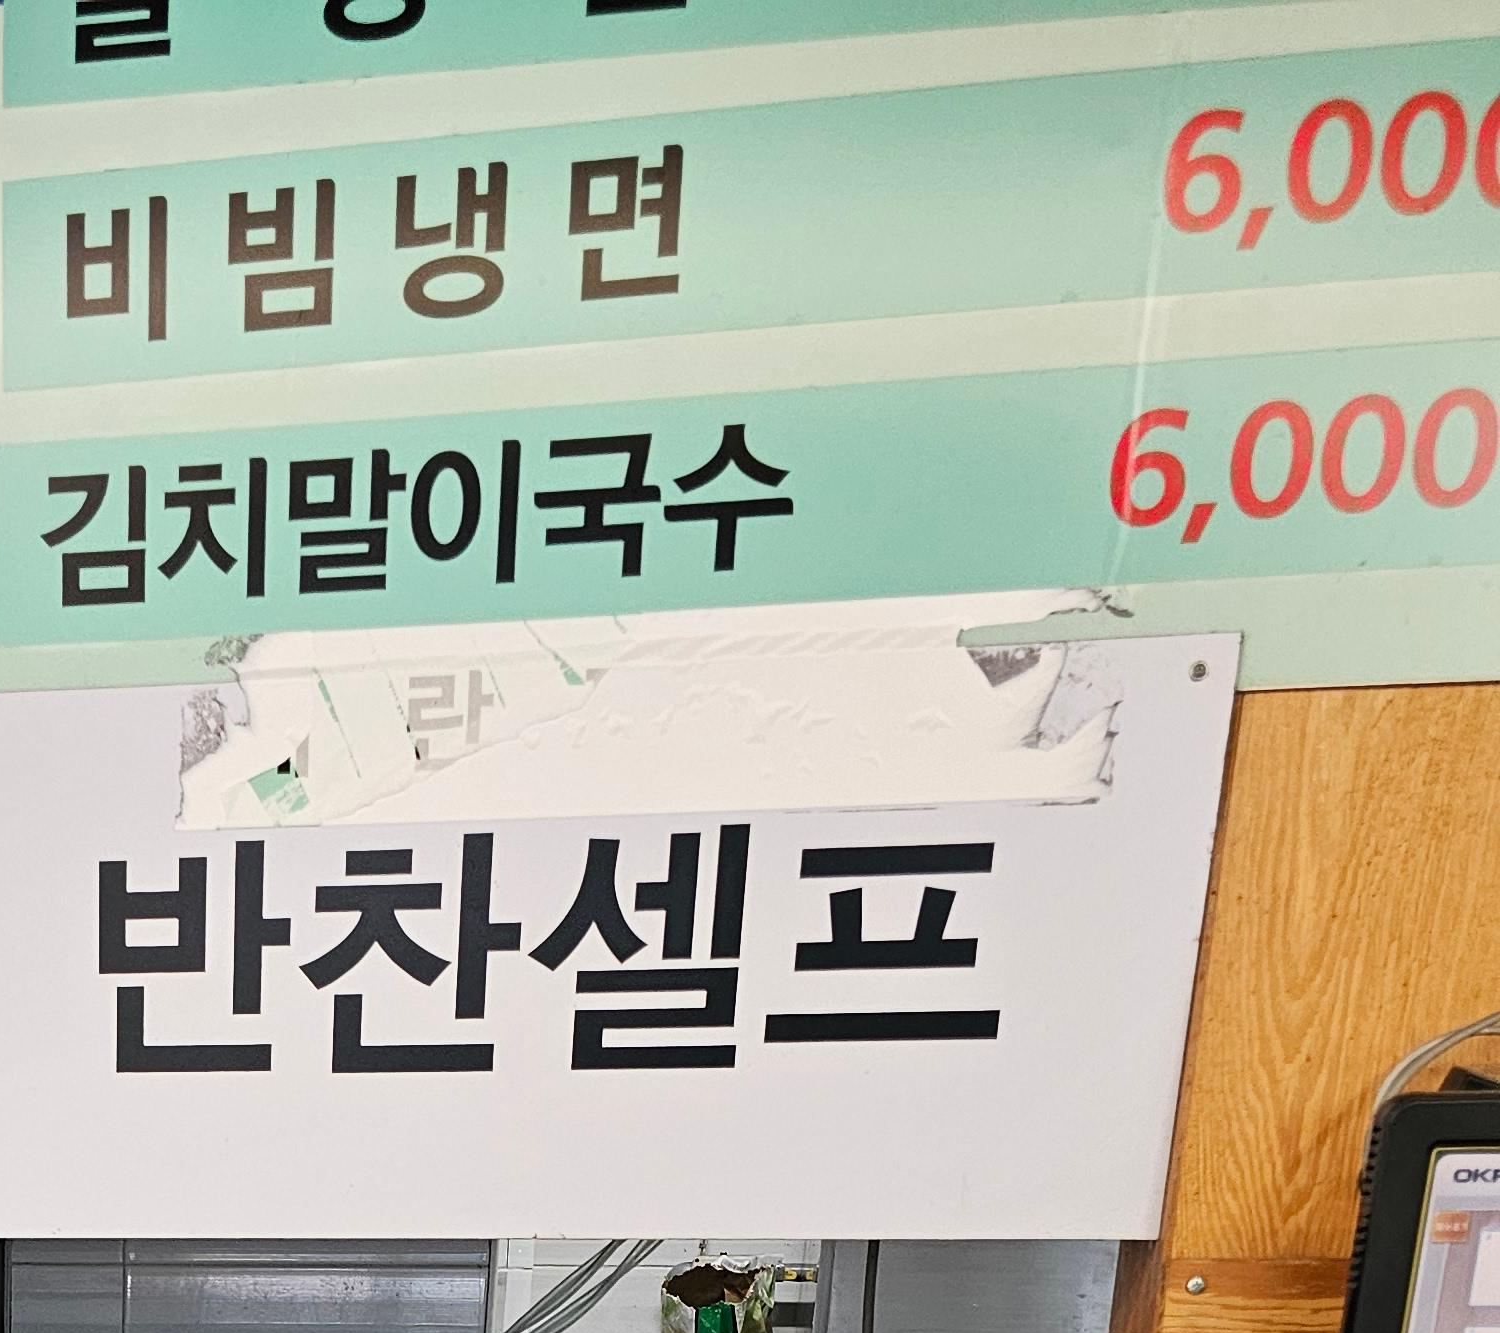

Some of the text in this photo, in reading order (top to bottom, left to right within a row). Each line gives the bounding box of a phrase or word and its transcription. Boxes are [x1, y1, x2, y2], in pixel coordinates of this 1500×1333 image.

[40, 388, 1500, 608] 김치말이국수 6,000
[98, 823, 1001, 1074] 반찬셀프
